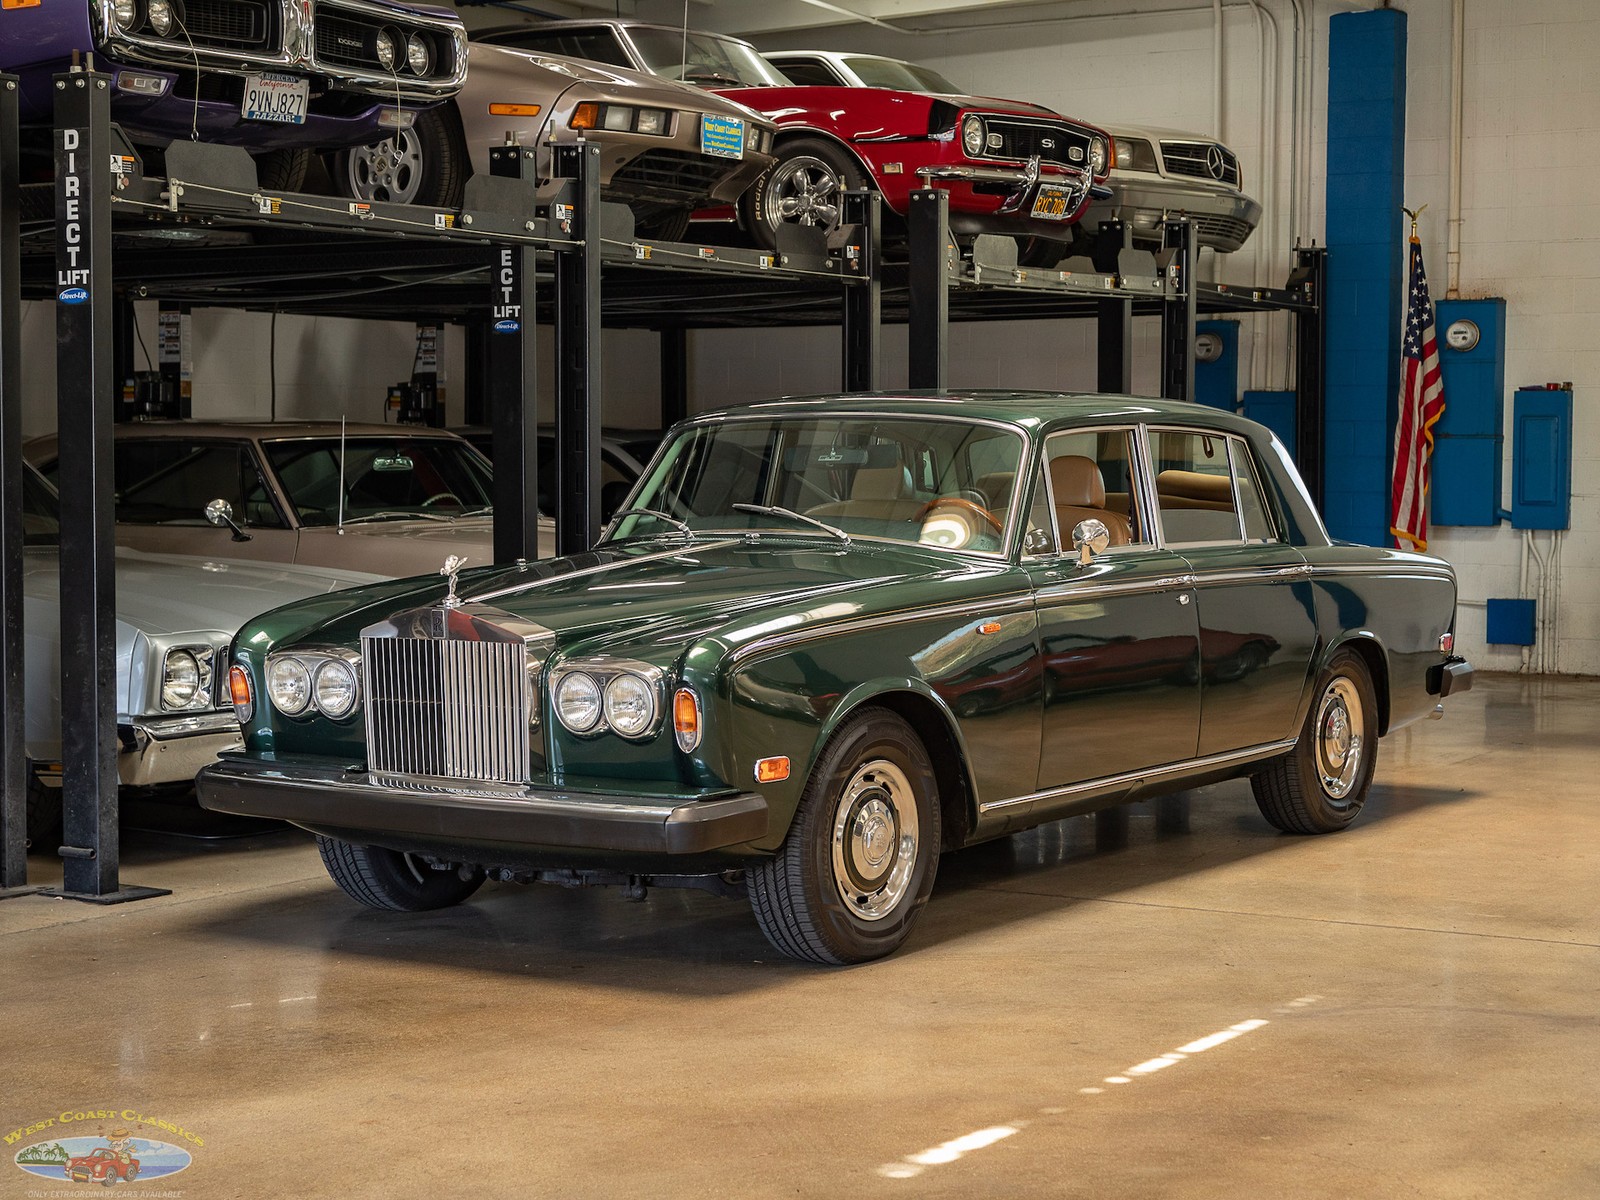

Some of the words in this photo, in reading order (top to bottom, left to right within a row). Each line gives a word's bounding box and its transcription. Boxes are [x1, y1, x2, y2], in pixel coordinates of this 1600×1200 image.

[248, 89, 303, 116] 9VNJ827
[63, 129, 81, 267] DIRECT
[58, 269, 90, 285] LIFT
[500, 249, 513, 304] ECT
[493, 305, 521, 318] LIFT
